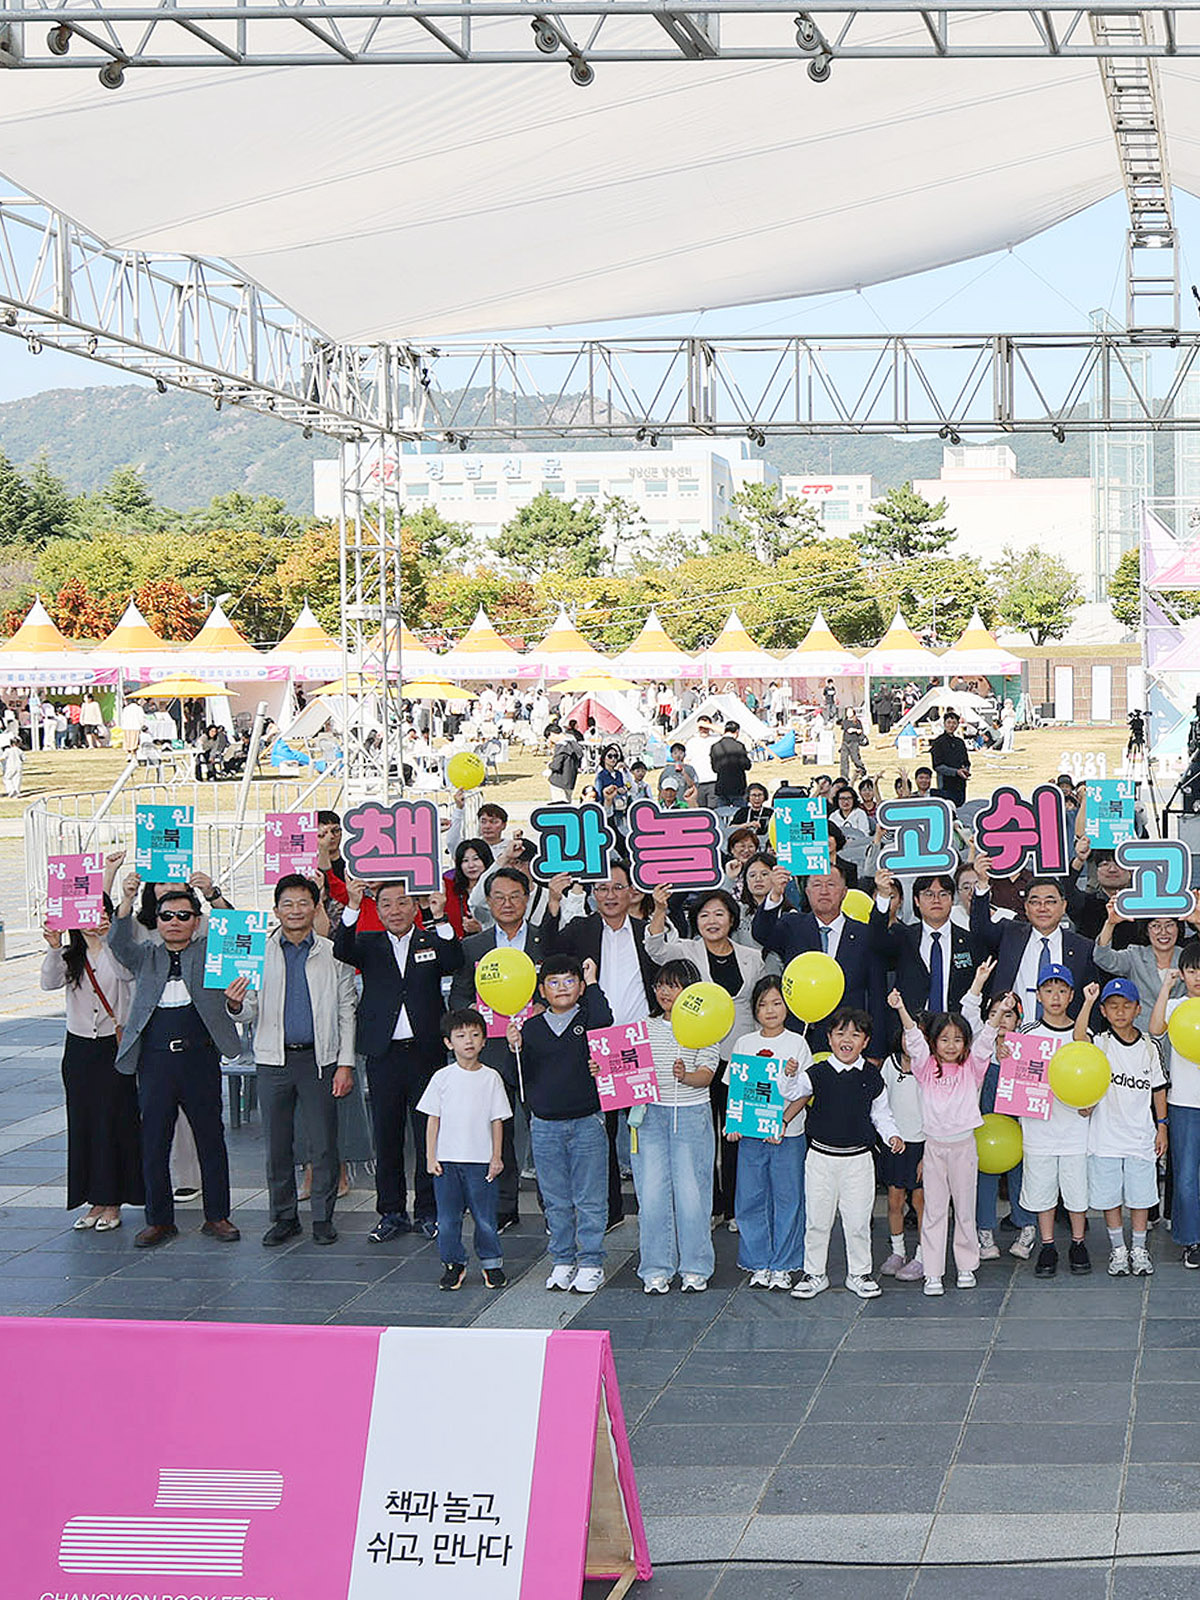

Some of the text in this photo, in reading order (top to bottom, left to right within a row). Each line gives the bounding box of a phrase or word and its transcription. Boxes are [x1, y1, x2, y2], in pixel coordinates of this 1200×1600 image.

[424, 456, 563, 481] 경남신문
[801, 484, 834, 494] CTR
[1086, 779, 1135, 802] 창 원
[136, 805, 194, 831] 창 원
[774, 795, 828, 824] 창 원
[1109, 800, 1123, 818] 북
[264, 812, 318, 837] 창 원
[800, 821, 816, 840] 북
[1085, 818, 1099, 838] 북
[163, 828, 180, 848] 북
[289, 834, 305, 852] 북
[348, 806, 440, 892] 책
[535, 810, 608, 874] 과
[632, 805, 717, 887] 놀
[883, 805, 950, 870] 고
[980, 789, 1063, 874] 쉬
[1120, 846, 1188, 911] 고
[47, 852, 105, 880] 창 원
[135, 848, 191, 883] 북 페
[264, 852, 280, 873] 북
[775, 841, 828, 875] 북 페
[73, 875, 89, 894] 북
[46, 896, 100, 925] 북 페
[208, 911, 267, 936] 창 원
[235, 933, 252, 955] 북
[204, 953, 223, 976] 북
[587, 1020, 650, 1056] 창 원
[620, 1047, 639, 1069] 북
[1027, 1059, 1045, 1082] 북
[730, 1061, 749, 1082] 창
[597, 1074, 659, 1102] 북 페
[755, 1081, 772, 1103] 북
[996, 1077, 1050, 1120] 북 페
[725, 1098, 780, 1140] 북 페
[385, 1491, 501, 1526] 책과 놀고,
[366, 1532, 513, 1567] 쉬고, 만나다
